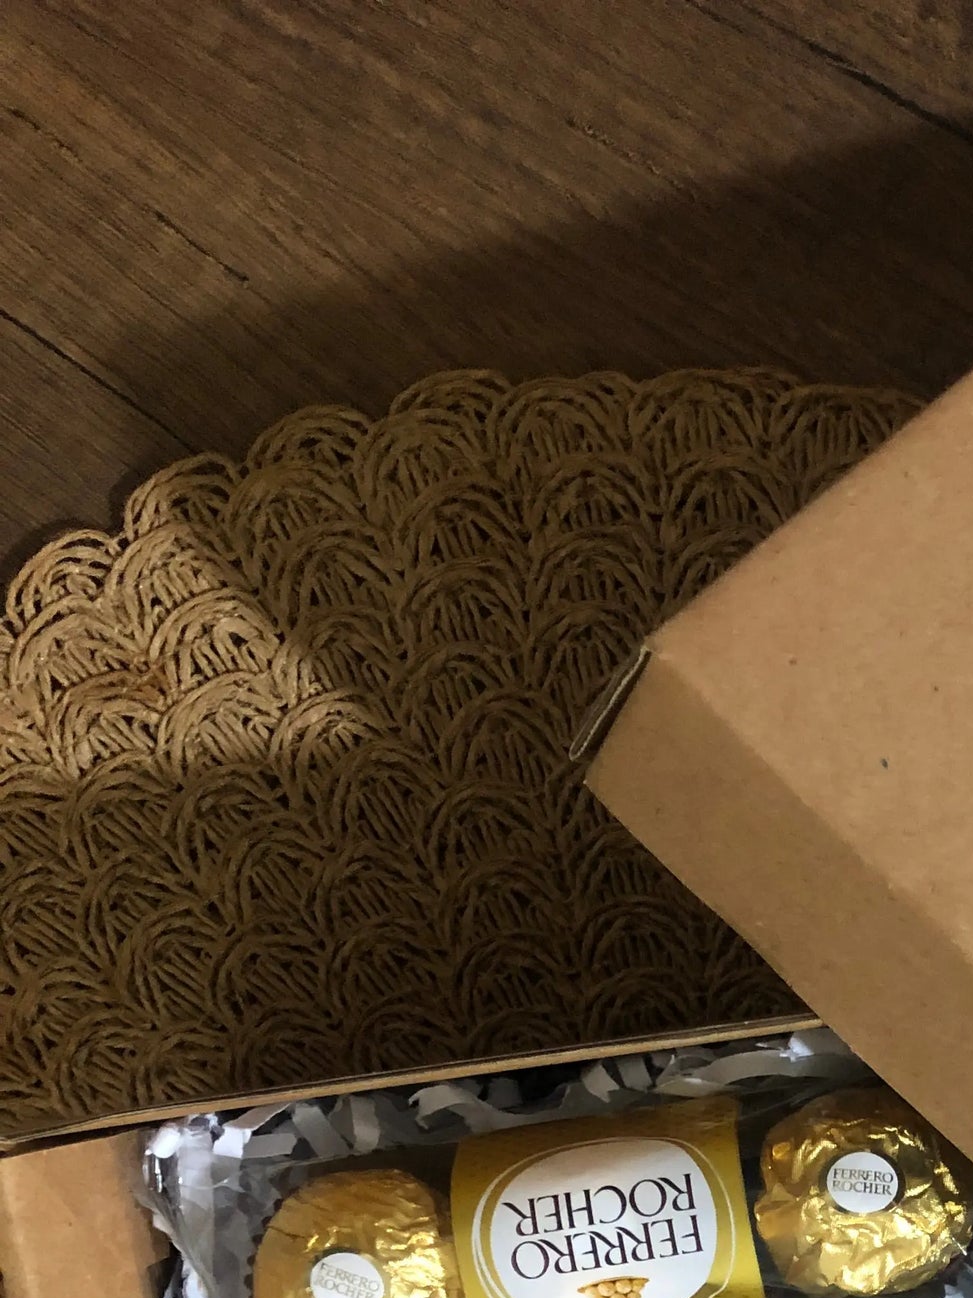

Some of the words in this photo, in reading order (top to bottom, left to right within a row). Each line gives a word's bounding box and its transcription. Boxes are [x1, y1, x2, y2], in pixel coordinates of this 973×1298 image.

[832, 1180, 892, 1195] ROCHER
[833, 1168, 894, 1184] FERRERO
[502, 1173, 696, 1237] ROCHER
[510, 1215, 704, 1280] FERRERO
[320, 1262, 380, 1292] FERRERO
